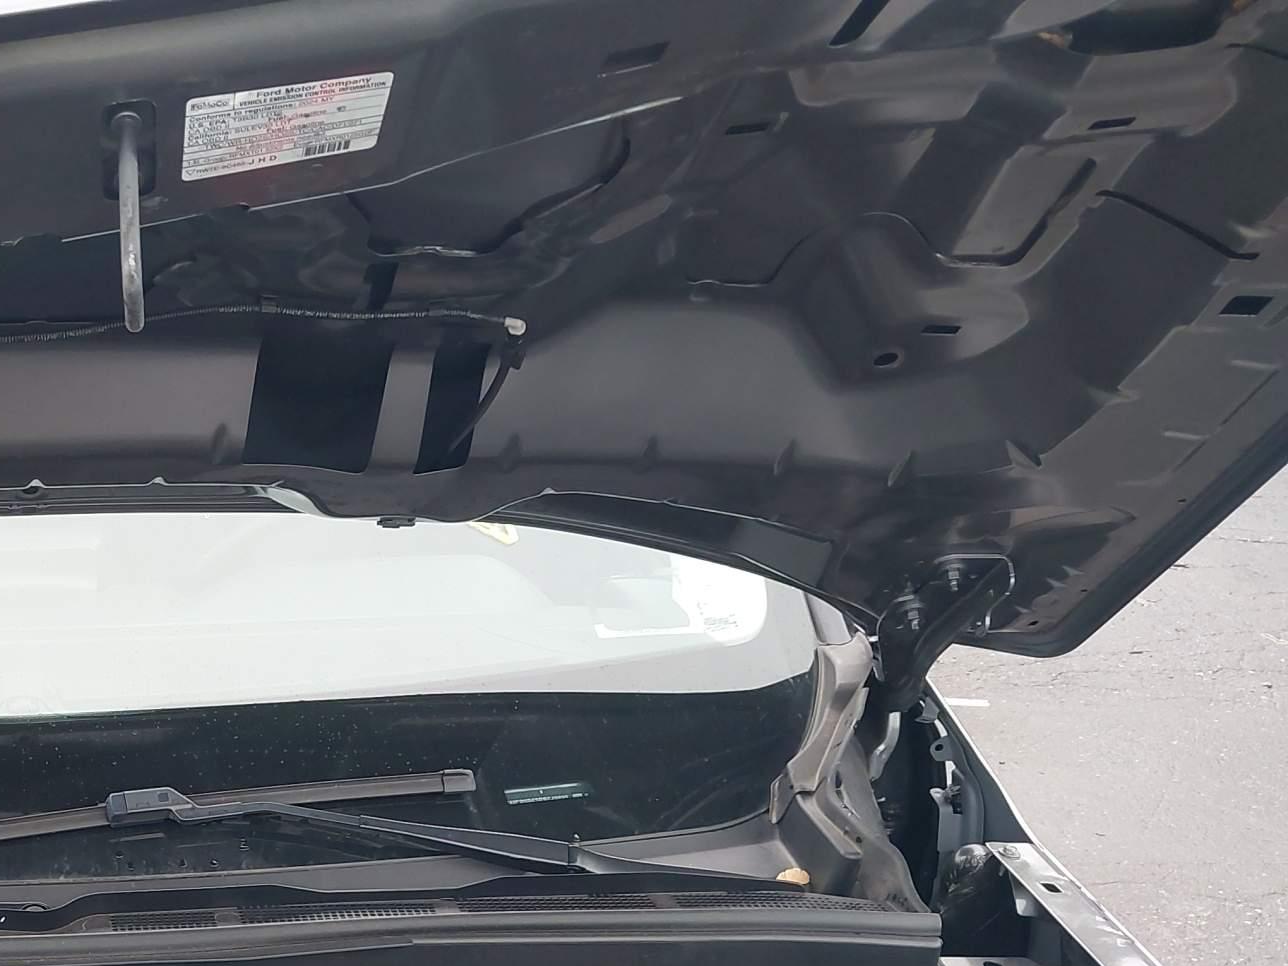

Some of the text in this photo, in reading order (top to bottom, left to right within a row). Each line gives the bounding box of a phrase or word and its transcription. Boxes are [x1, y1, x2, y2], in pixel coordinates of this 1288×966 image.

[239, 82, 386, 107] VEHICLE EMISSION CONTROL INFORMATION
[256, 78, 372, 98] Ford Motor Company
